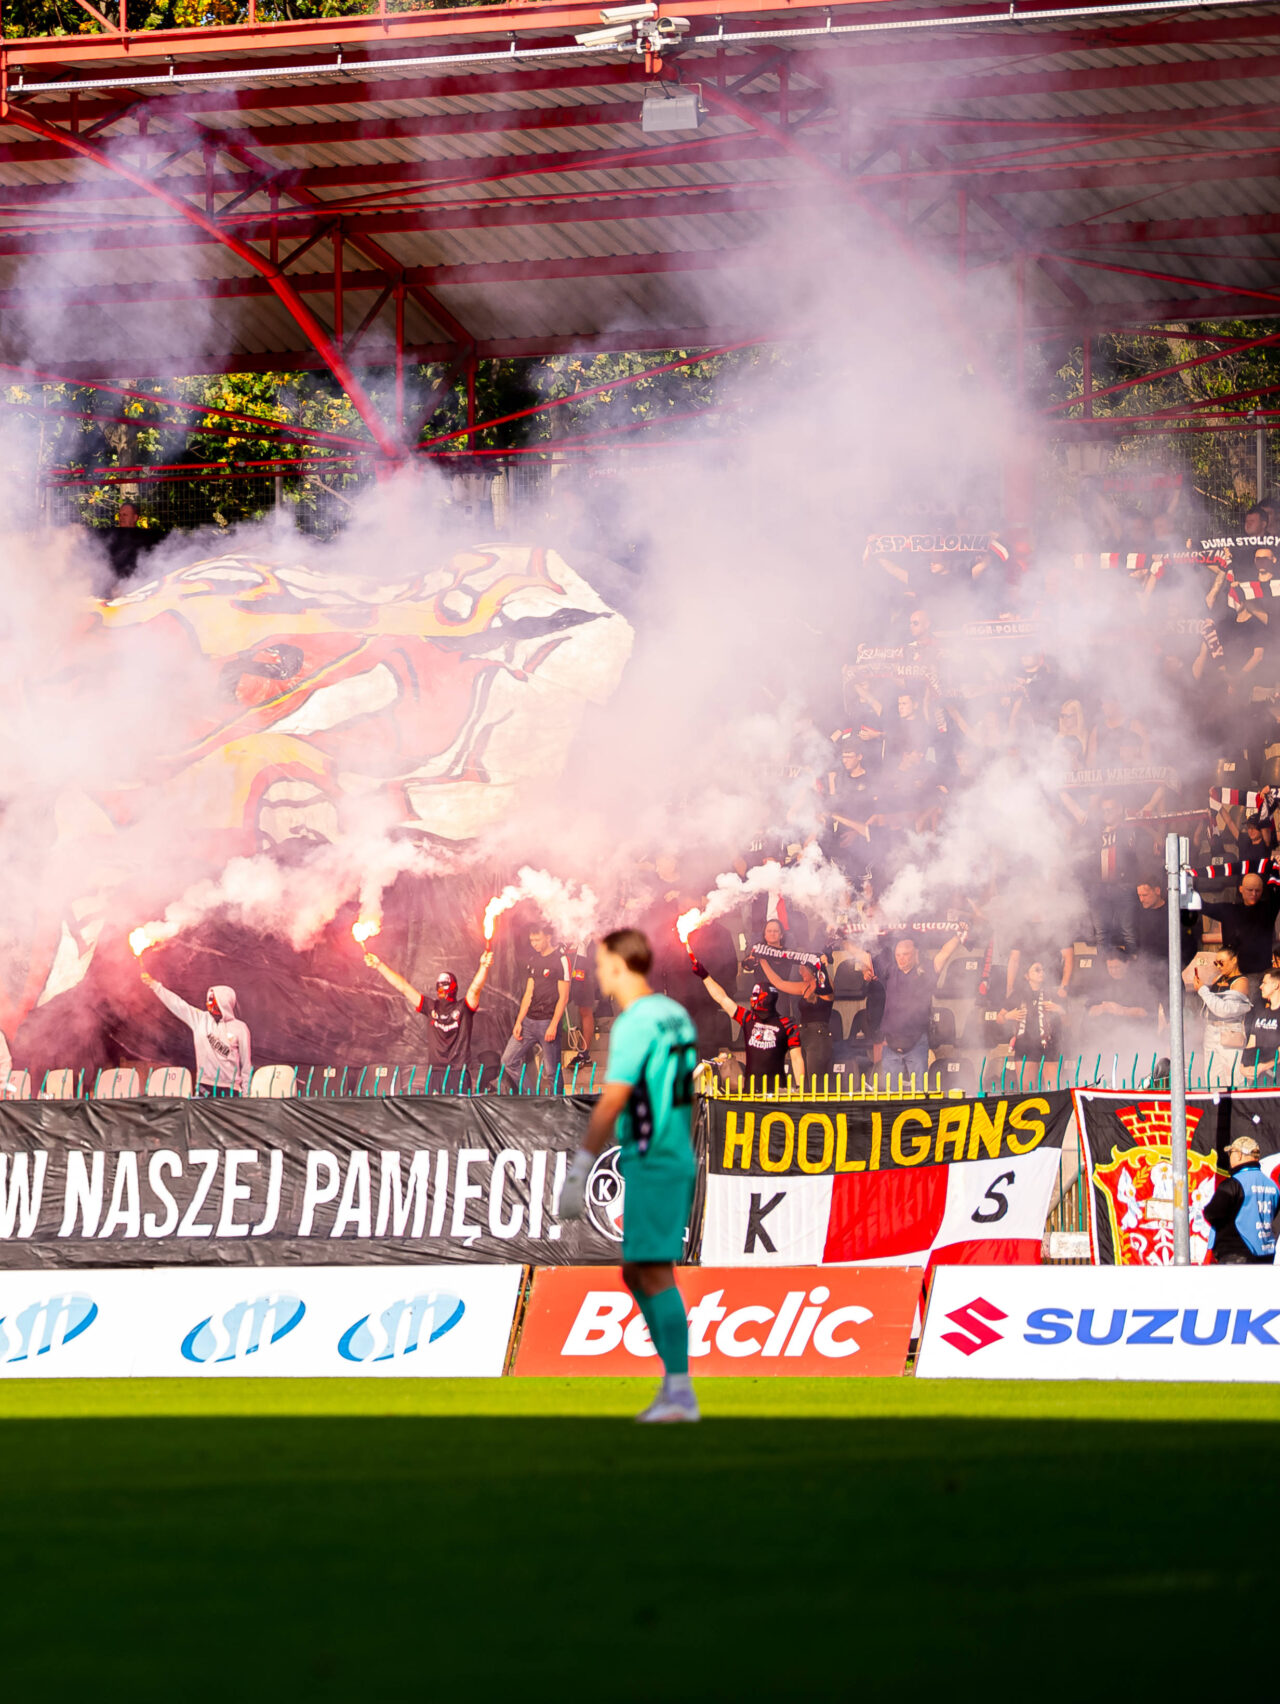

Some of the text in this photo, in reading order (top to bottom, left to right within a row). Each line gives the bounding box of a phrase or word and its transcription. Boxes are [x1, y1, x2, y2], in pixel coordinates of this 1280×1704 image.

[1201, 537, 1235, 549] DUMA
[722, 1097, 1051, 1174] HOOLIGANS
[58, 1149, 284, 1239] NASZEJ
[297, 1148, 567, 1247] PAMIĘCI!
[744, 1170, 1016, 1254] K S
